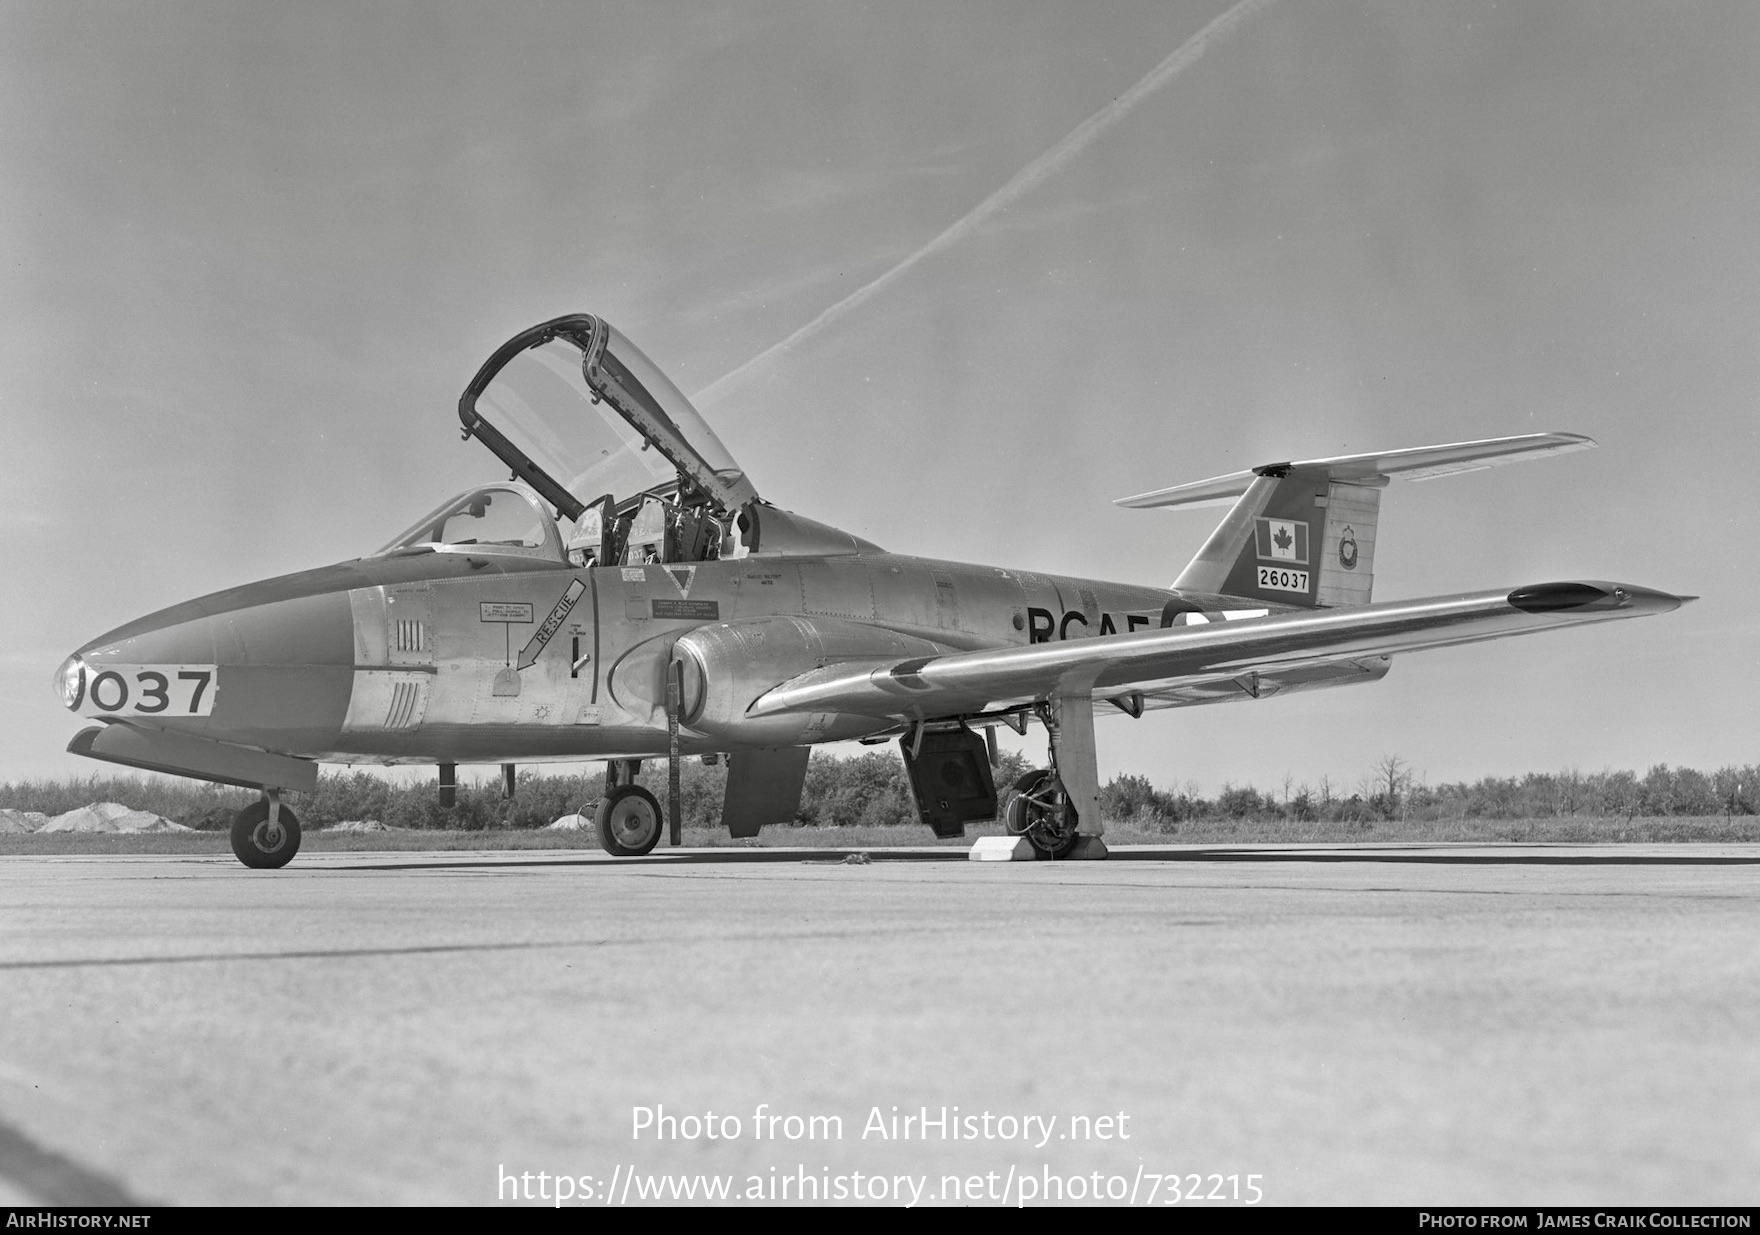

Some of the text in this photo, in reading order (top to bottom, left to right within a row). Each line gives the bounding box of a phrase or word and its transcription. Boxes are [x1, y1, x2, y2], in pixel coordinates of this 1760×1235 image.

[570, 554, 584, 564] 037
[628, 549, 643, 561] 037
[1260, 569, 1307, 590] 26037
[536, 595, 575, 645] RESCUE
[90, 671, 211, 714] 037
[670, 714, 678, 745] REMOVE
